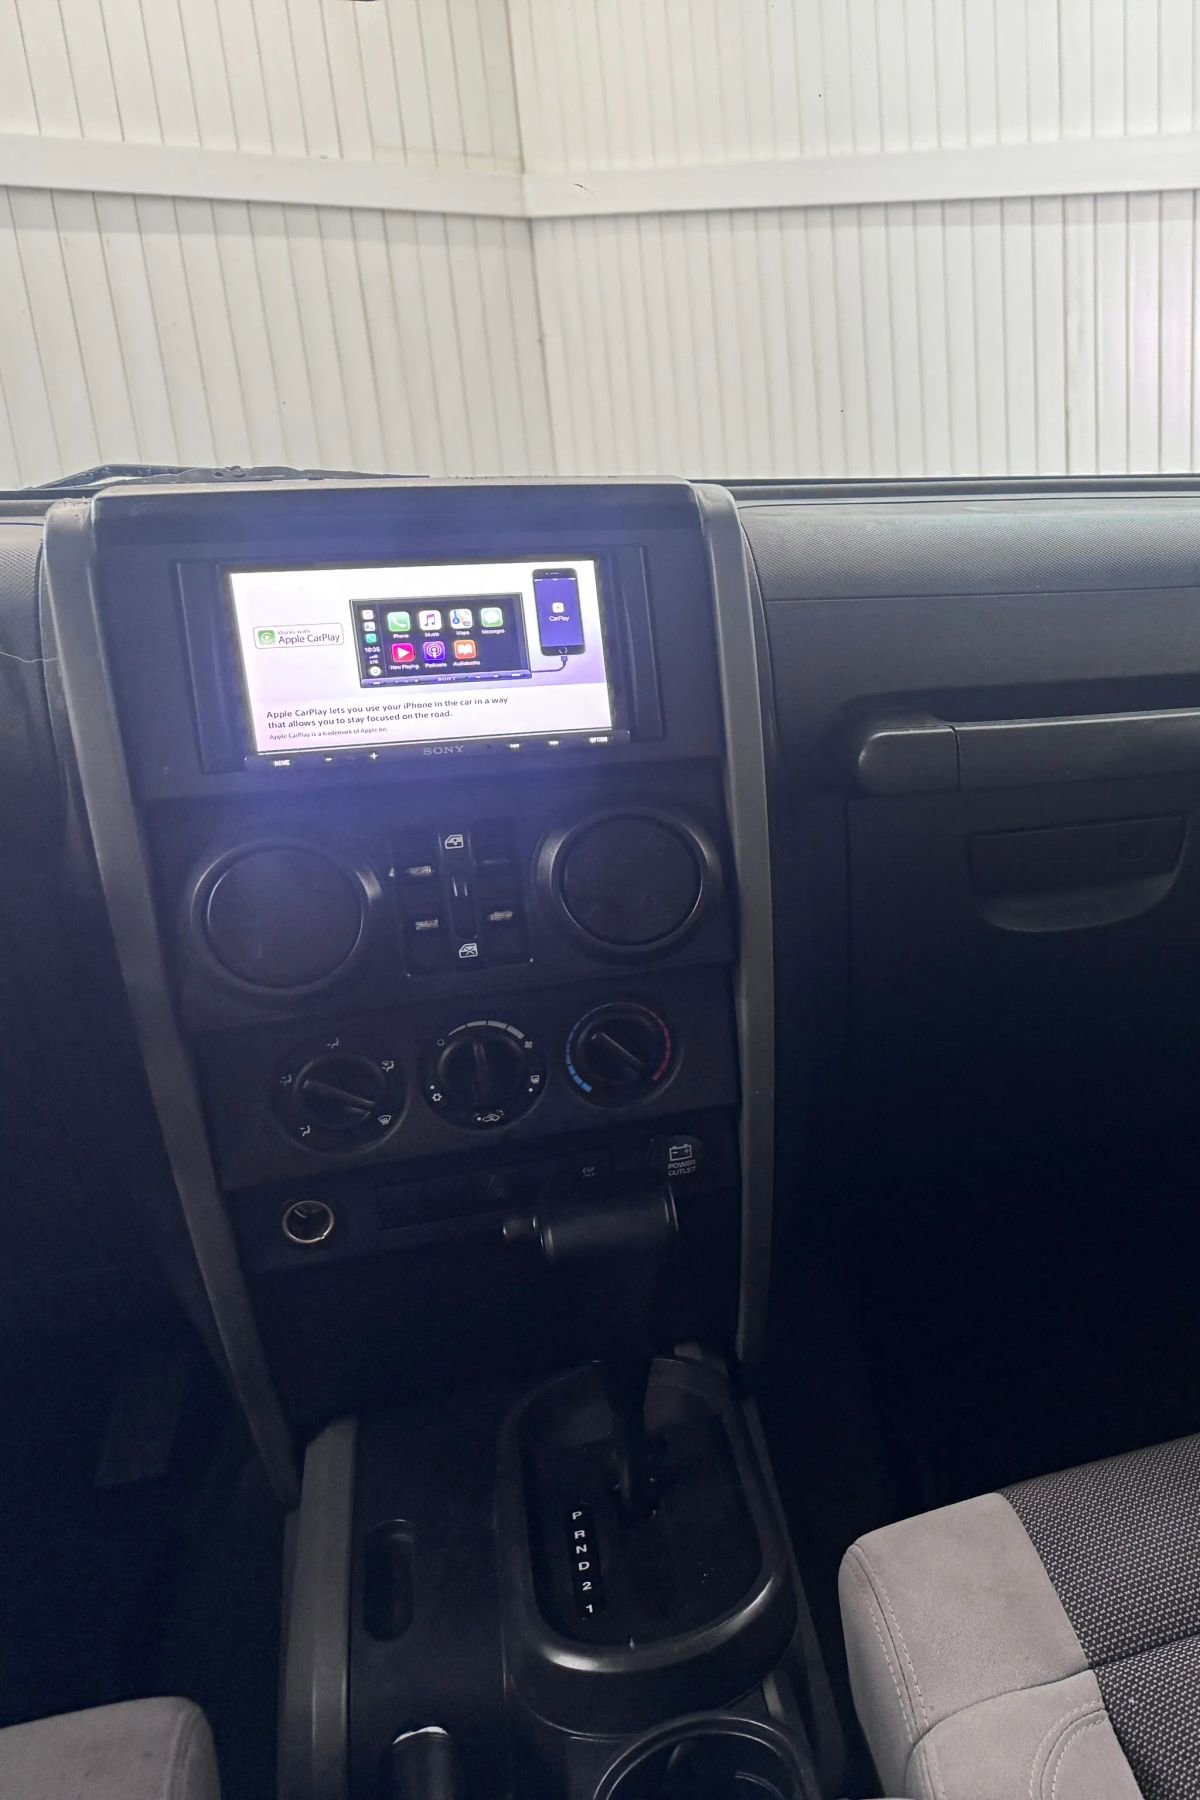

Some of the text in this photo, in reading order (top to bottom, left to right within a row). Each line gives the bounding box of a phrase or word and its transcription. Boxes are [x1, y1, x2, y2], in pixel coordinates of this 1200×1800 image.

[278, 634, 340, 644] Apple CarPlay
[267, 711, 292, 719] Apple
[295, 708, 327, 717] CarPlay
[382, 704, 401, 712] your
[288, 720, 316, 728] allows
[367, 713, 400, 722] focused
[430, 710, 452, 718] road.
[423, 745, 464, 756] SONY
[668, 1159, 696, 1169] POWER
[668, 1166, 696, 1176] OUTLET
[572, 1511, 583, 1520] P
[574, 1530, 586, 1539] R
[576, 1544, 587, 1554] N
[578, 1561, 590, 1571] D
[582, 1582, 592, 1591] 2
[586, 1604, 594, 1613] 1
